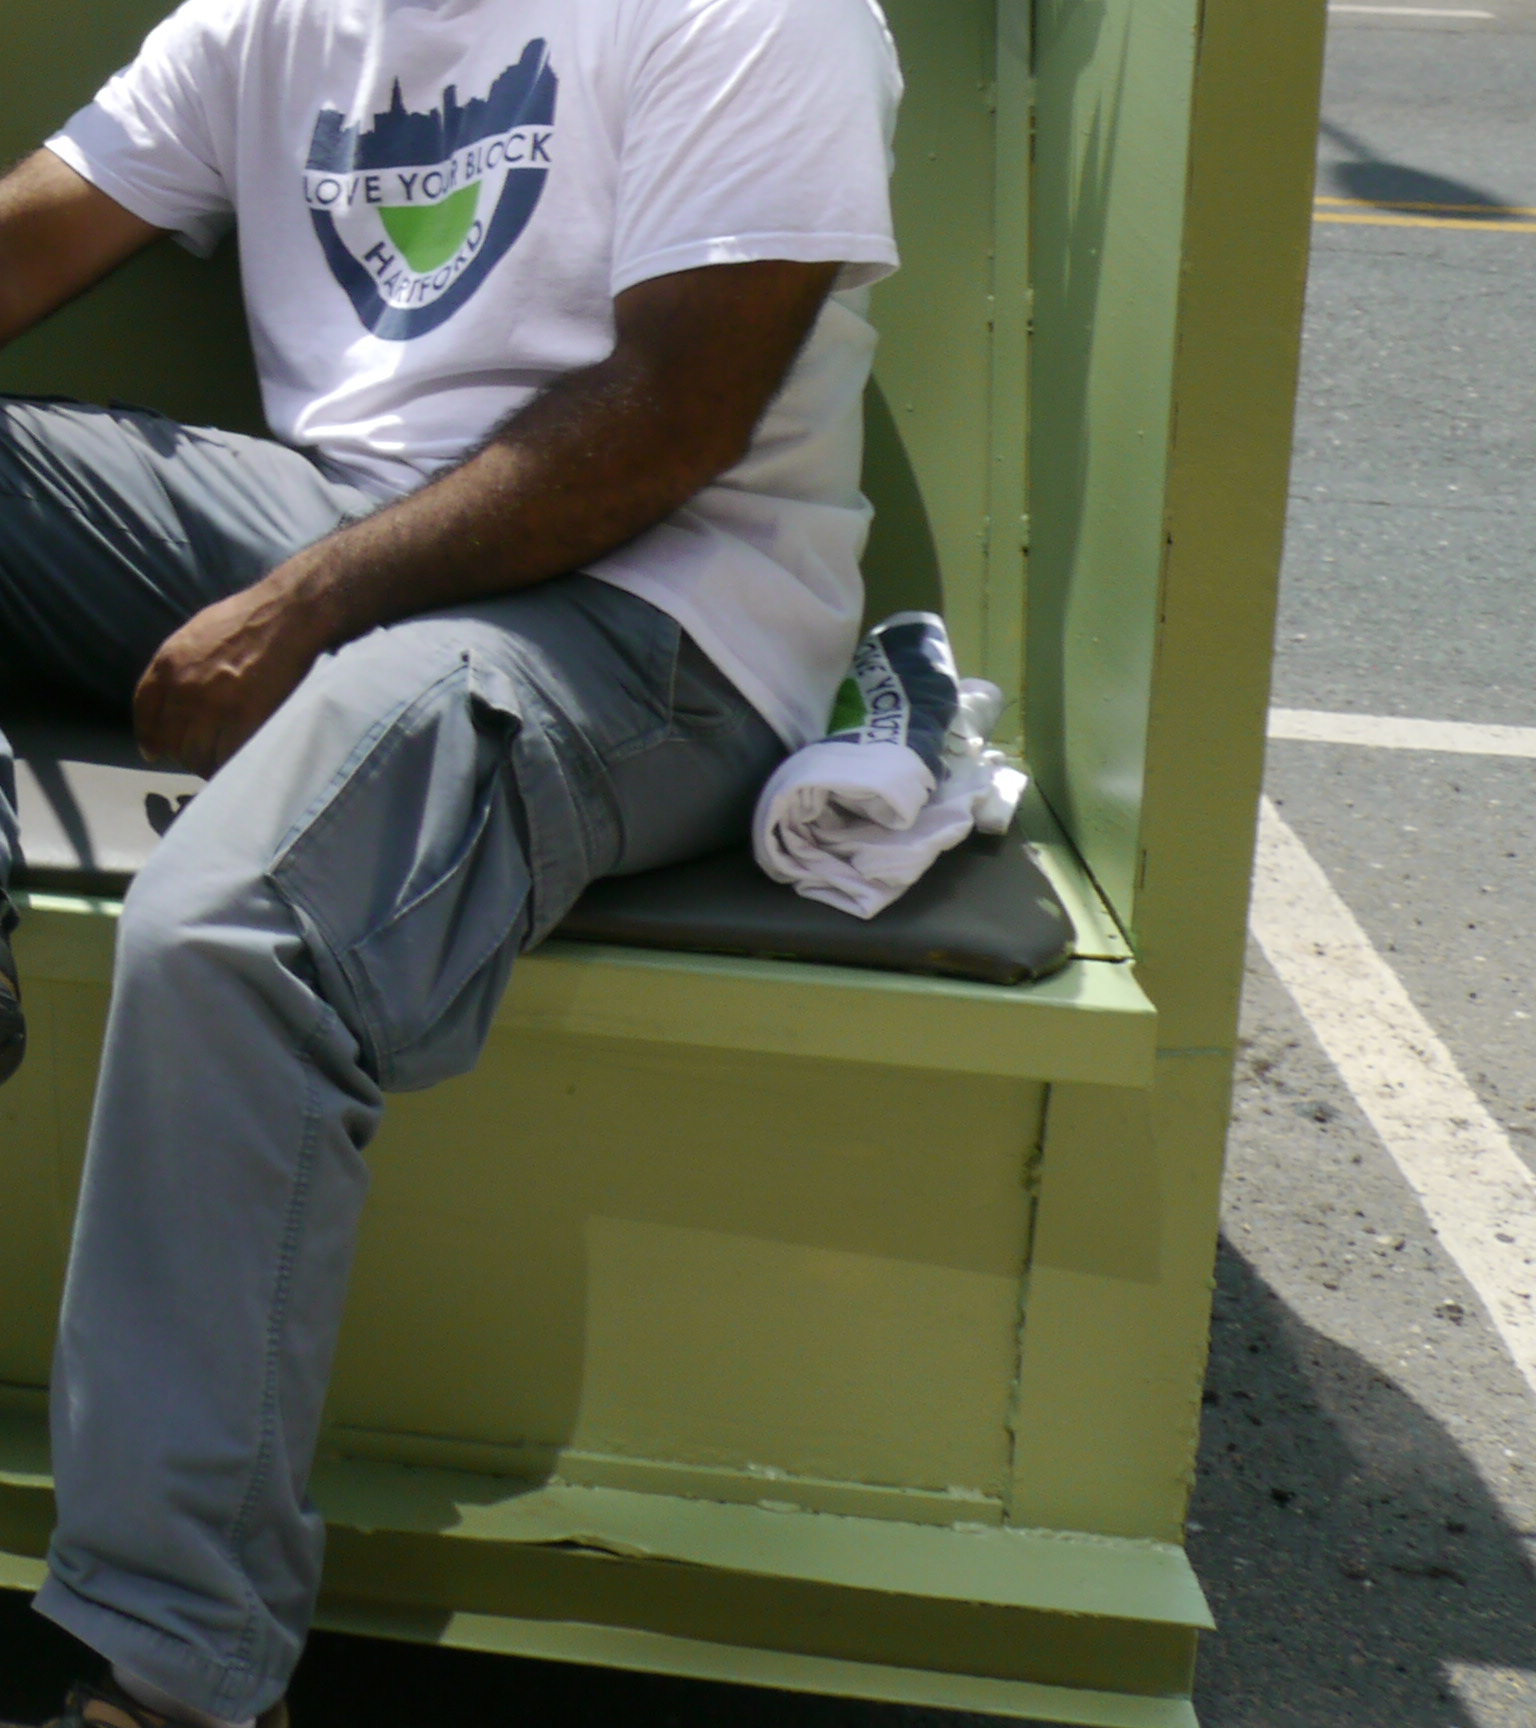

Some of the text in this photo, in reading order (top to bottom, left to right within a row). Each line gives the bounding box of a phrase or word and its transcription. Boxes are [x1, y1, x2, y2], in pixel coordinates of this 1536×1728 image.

[304, 132, 553, 208] LOVE YOUR BLOCK
